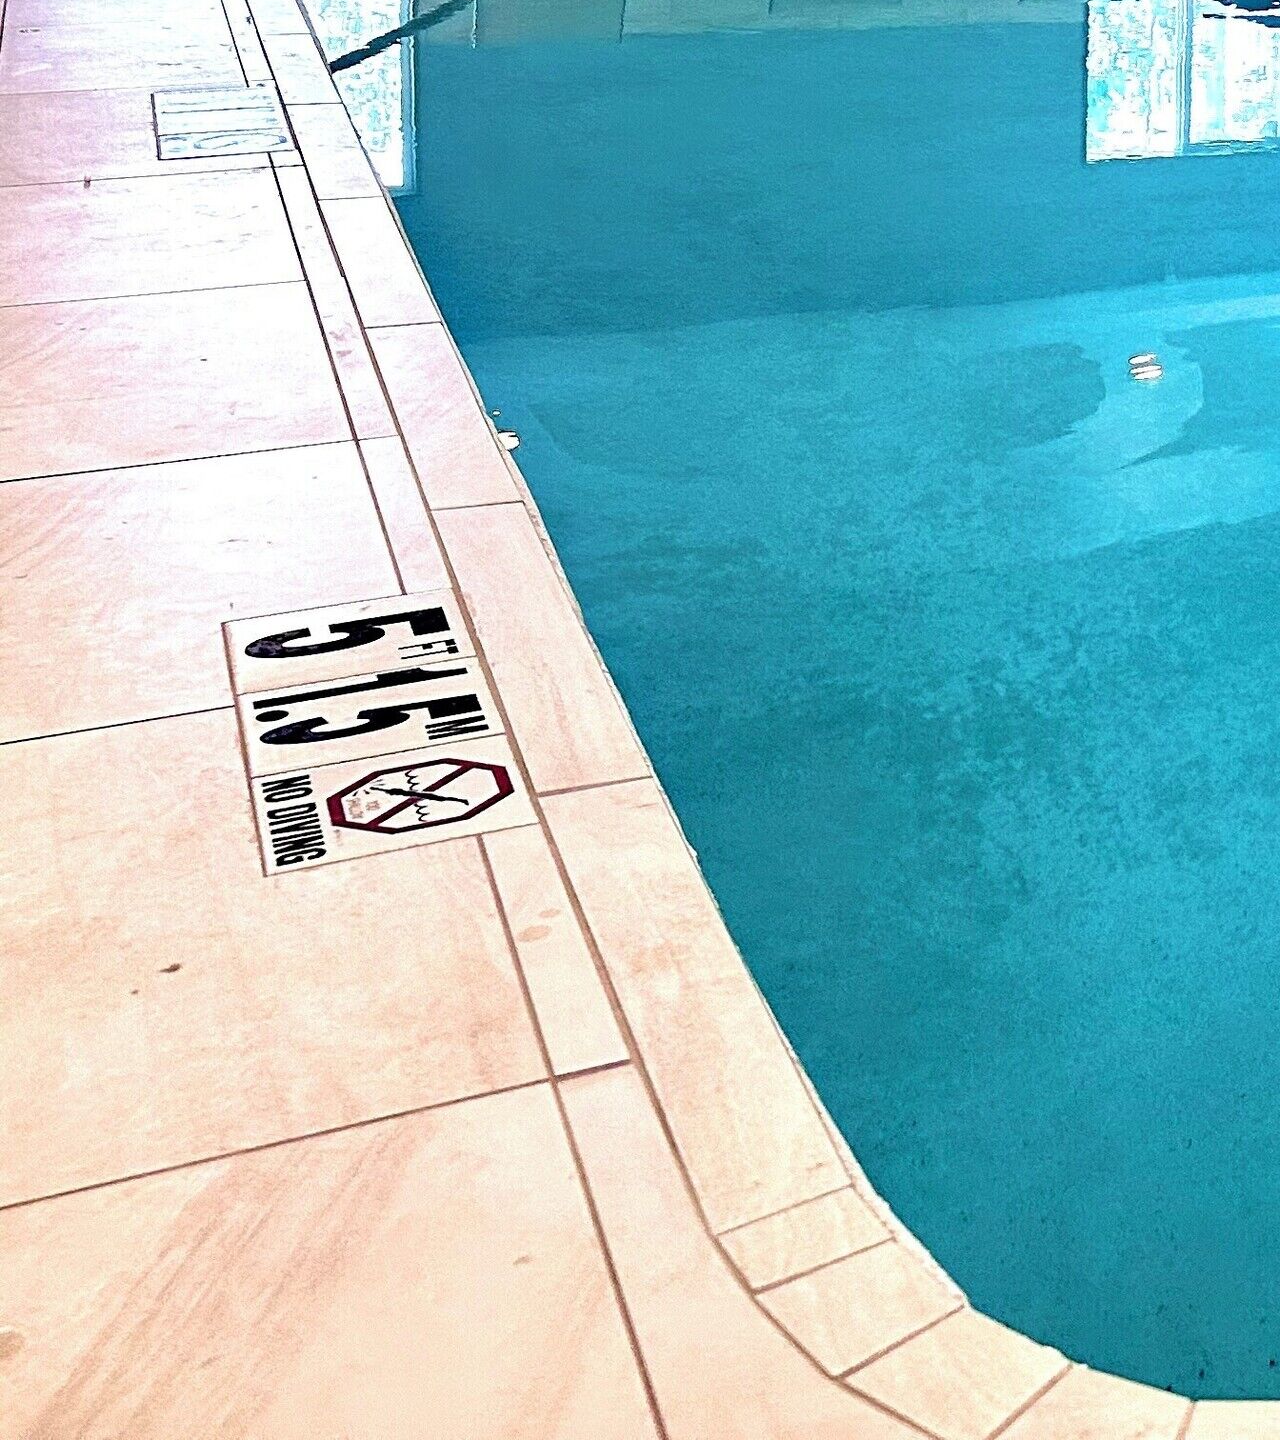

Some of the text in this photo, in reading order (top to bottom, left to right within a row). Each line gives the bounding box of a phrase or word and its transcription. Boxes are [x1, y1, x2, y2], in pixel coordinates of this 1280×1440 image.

[244, 606, 450, 659] 5
[261, 774, 327, 867] NO DIVING
